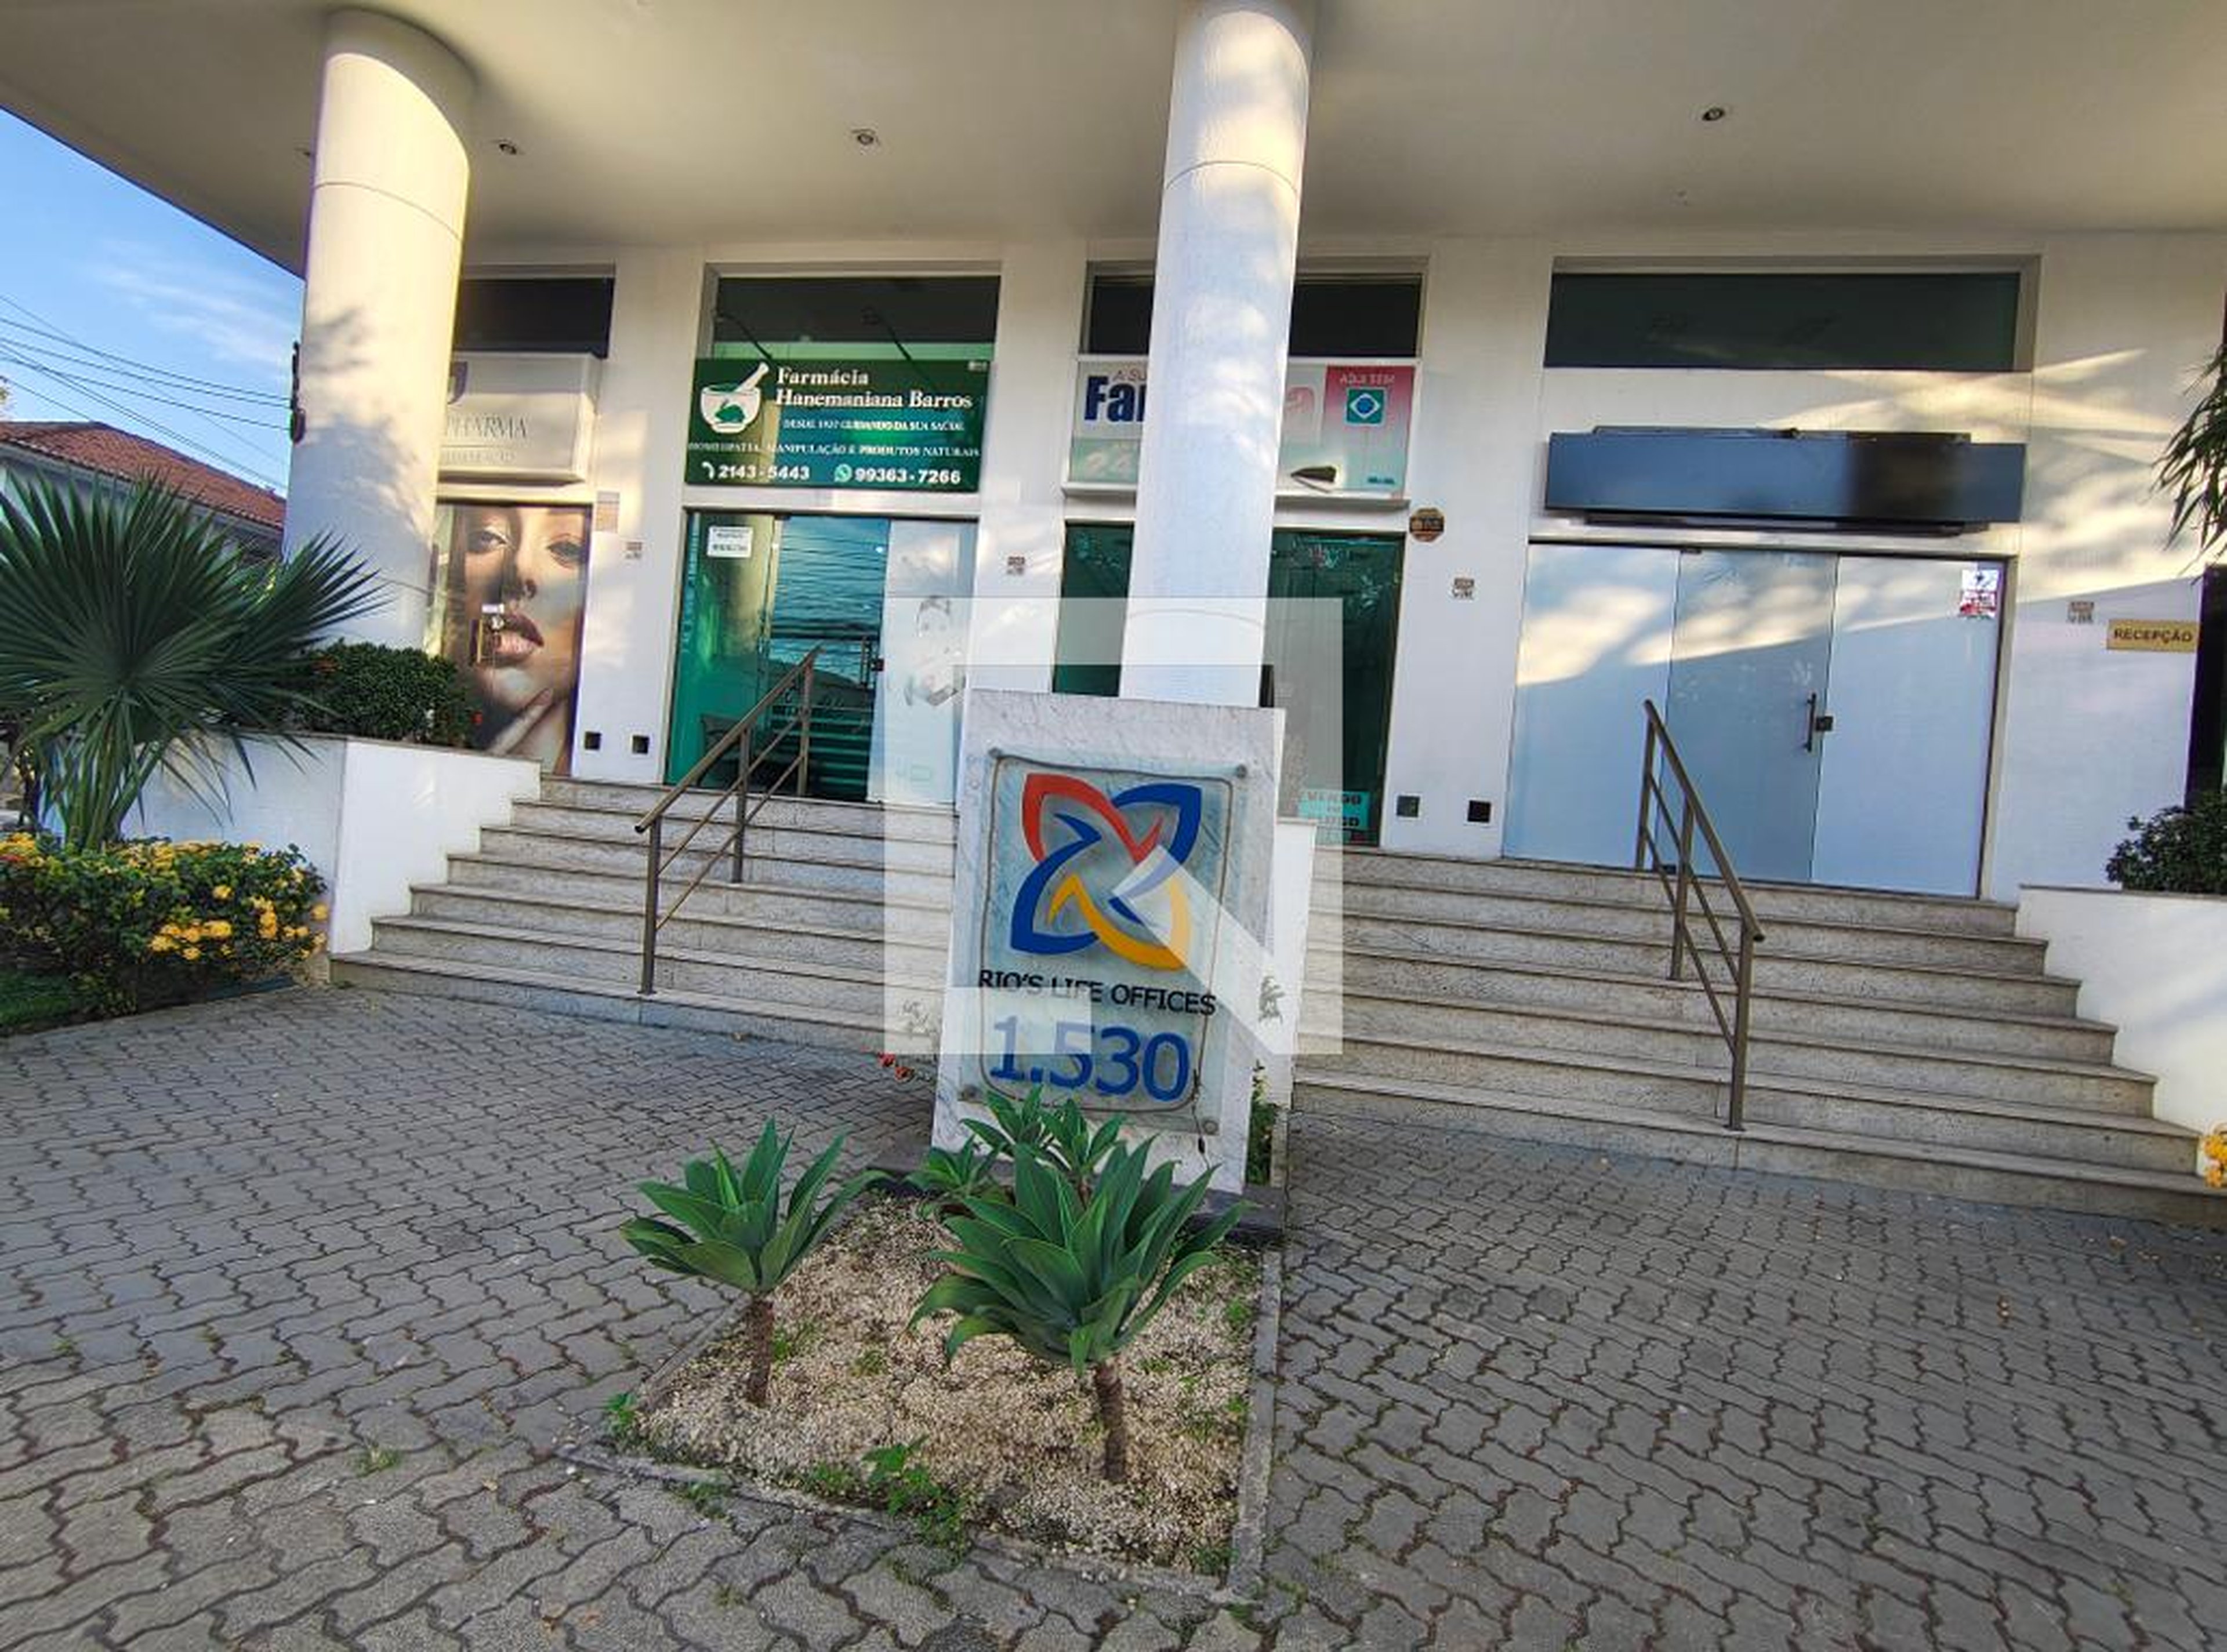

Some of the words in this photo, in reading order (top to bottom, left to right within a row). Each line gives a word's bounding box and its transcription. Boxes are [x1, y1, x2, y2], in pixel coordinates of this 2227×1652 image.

[777, 366, 869, 386] Farmácia
[775, 388, 902, 407] Hanemaniana
[908, 390, 973, 408] Barros
[859, 445, 920, 456] PRODUTOS
[923, 446, 980, 457] NATURAIS
[2114, 627, 2193, 644] RECEPÇÃO
[978, 969, 1043, 996] RIO'S
[1051, 978, 1103, 1002] LIFE
[1111, 985, 1217, 1016] OFFICES
[990, 1015, 1190, 1101] 1.530
